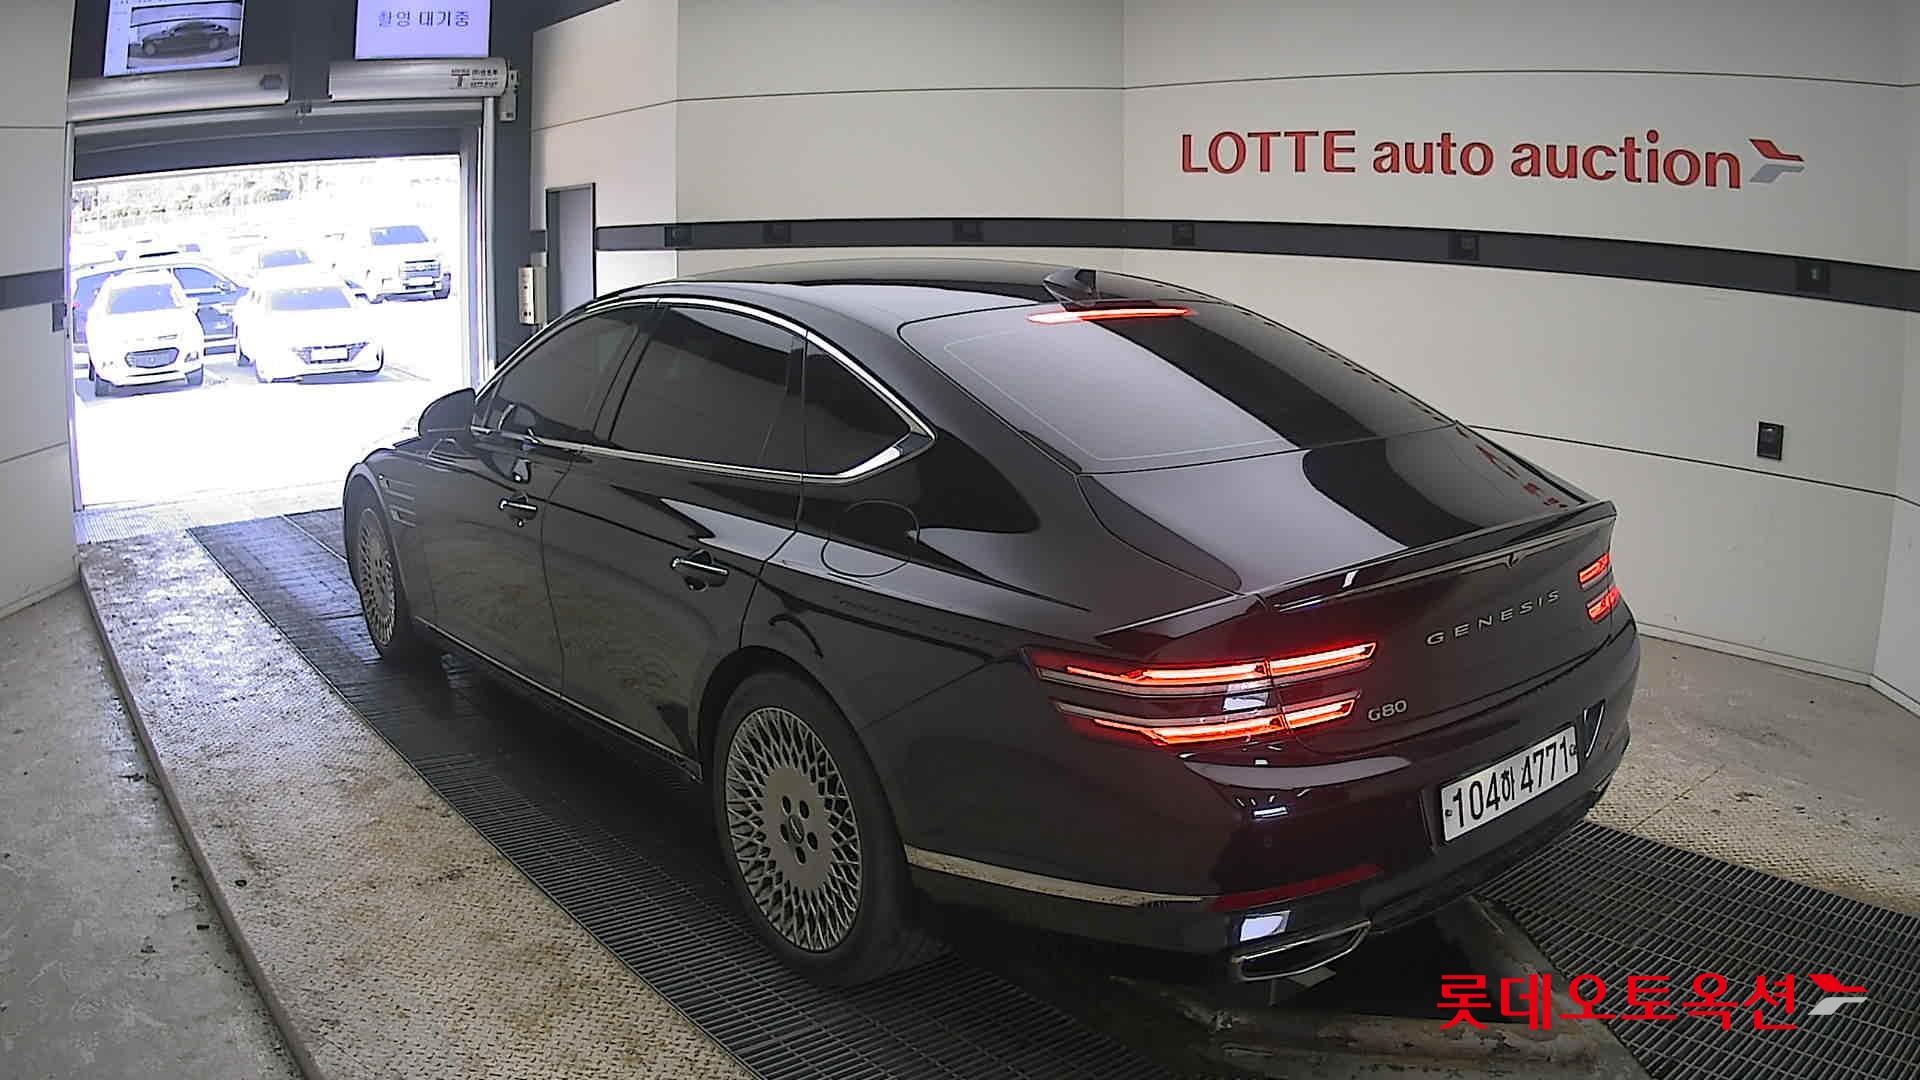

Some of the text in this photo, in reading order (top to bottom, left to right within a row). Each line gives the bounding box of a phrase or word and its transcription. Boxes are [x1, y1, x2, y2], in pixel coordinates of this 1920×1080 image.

[419, 10, 470, 28] 대기중
[1181, 129, 1742, 189] LOTTE auto auction
[1426, 590, 1560, 645] GENESIS
[1367, 700, 1408, 721] G80
[1452, 735, 1569, 828] 104하 4771
